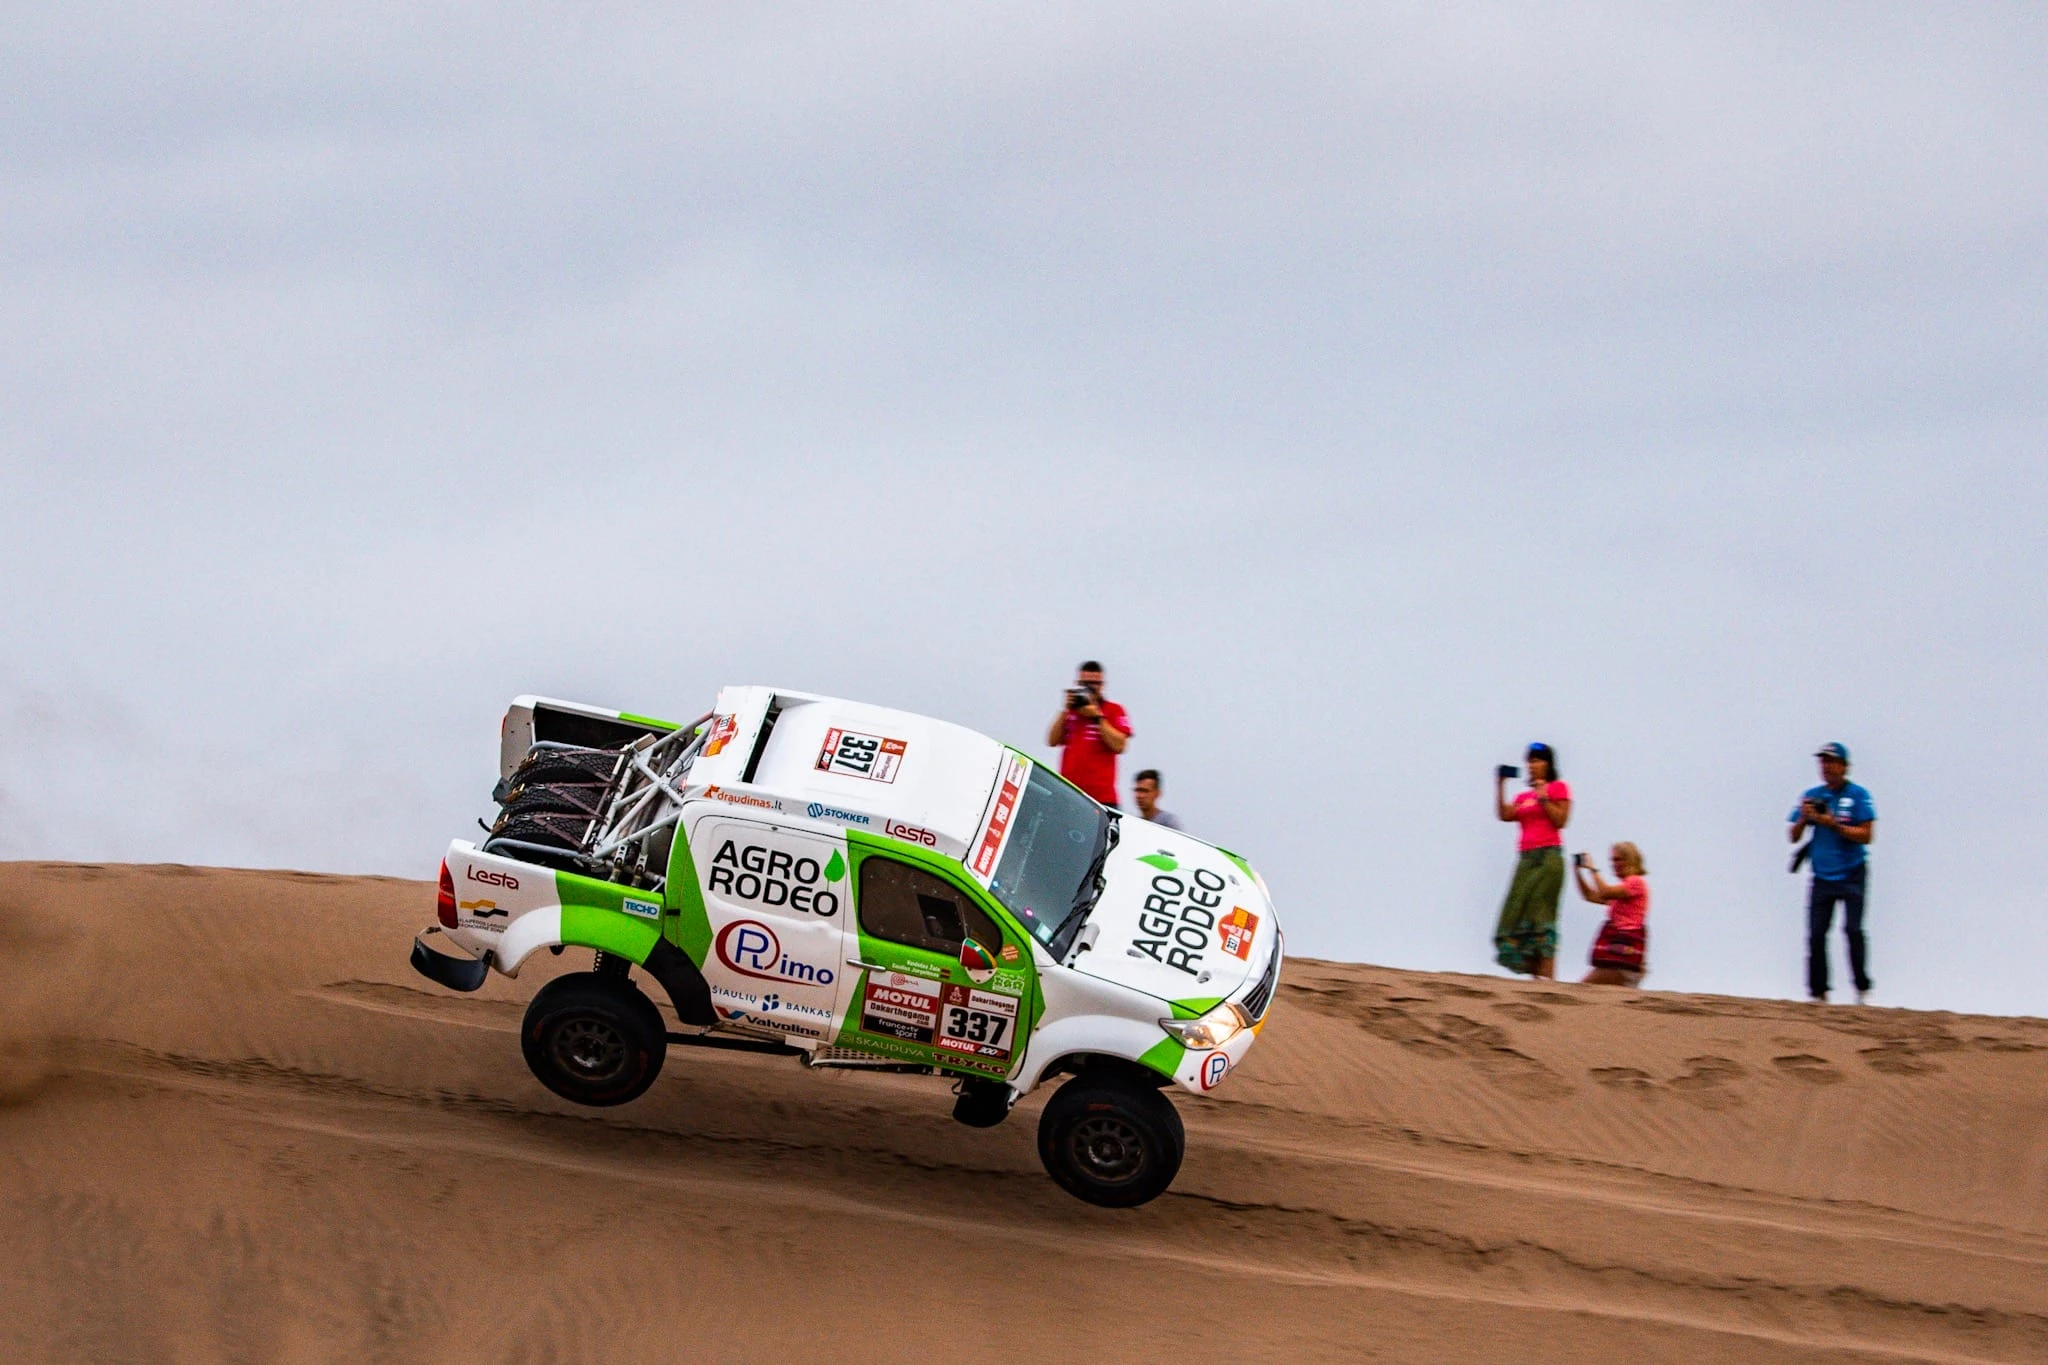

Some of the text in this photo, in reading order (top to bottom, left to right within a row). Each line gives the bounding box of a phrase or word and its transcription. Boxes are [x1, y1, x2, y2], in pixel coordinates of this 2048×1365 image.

[835, 734, 878, 773] 337
[717, 791, 783, 810] draudimas.lt
[825, 808, 870, 825] STOKKER
[885, 819, 937, 847] Lesta
[712, 839, 820, 884] AGRO
[467, 864, 520, 890] Lesta
[708, 866, 839, 917] RODEO
[625, 900, 658, 916] TECHO
[1132, 874, 1185, 963] AGRO
[1166, 868, 1226, 976] RODEO
[711, 984, 832, 1018] ŠIAULIŲ BANKAS
[873, 988, 931, 1009] MOTUL
[746, 1014, 820, 1036] Valvoline
[870, 1002, 931, 1022] Dakarthegame
[895, 1028, 917, 1039] sport
[947, 1008, 1008, 1045] 337
[940, 1038, 975, 1052] MOTUL
